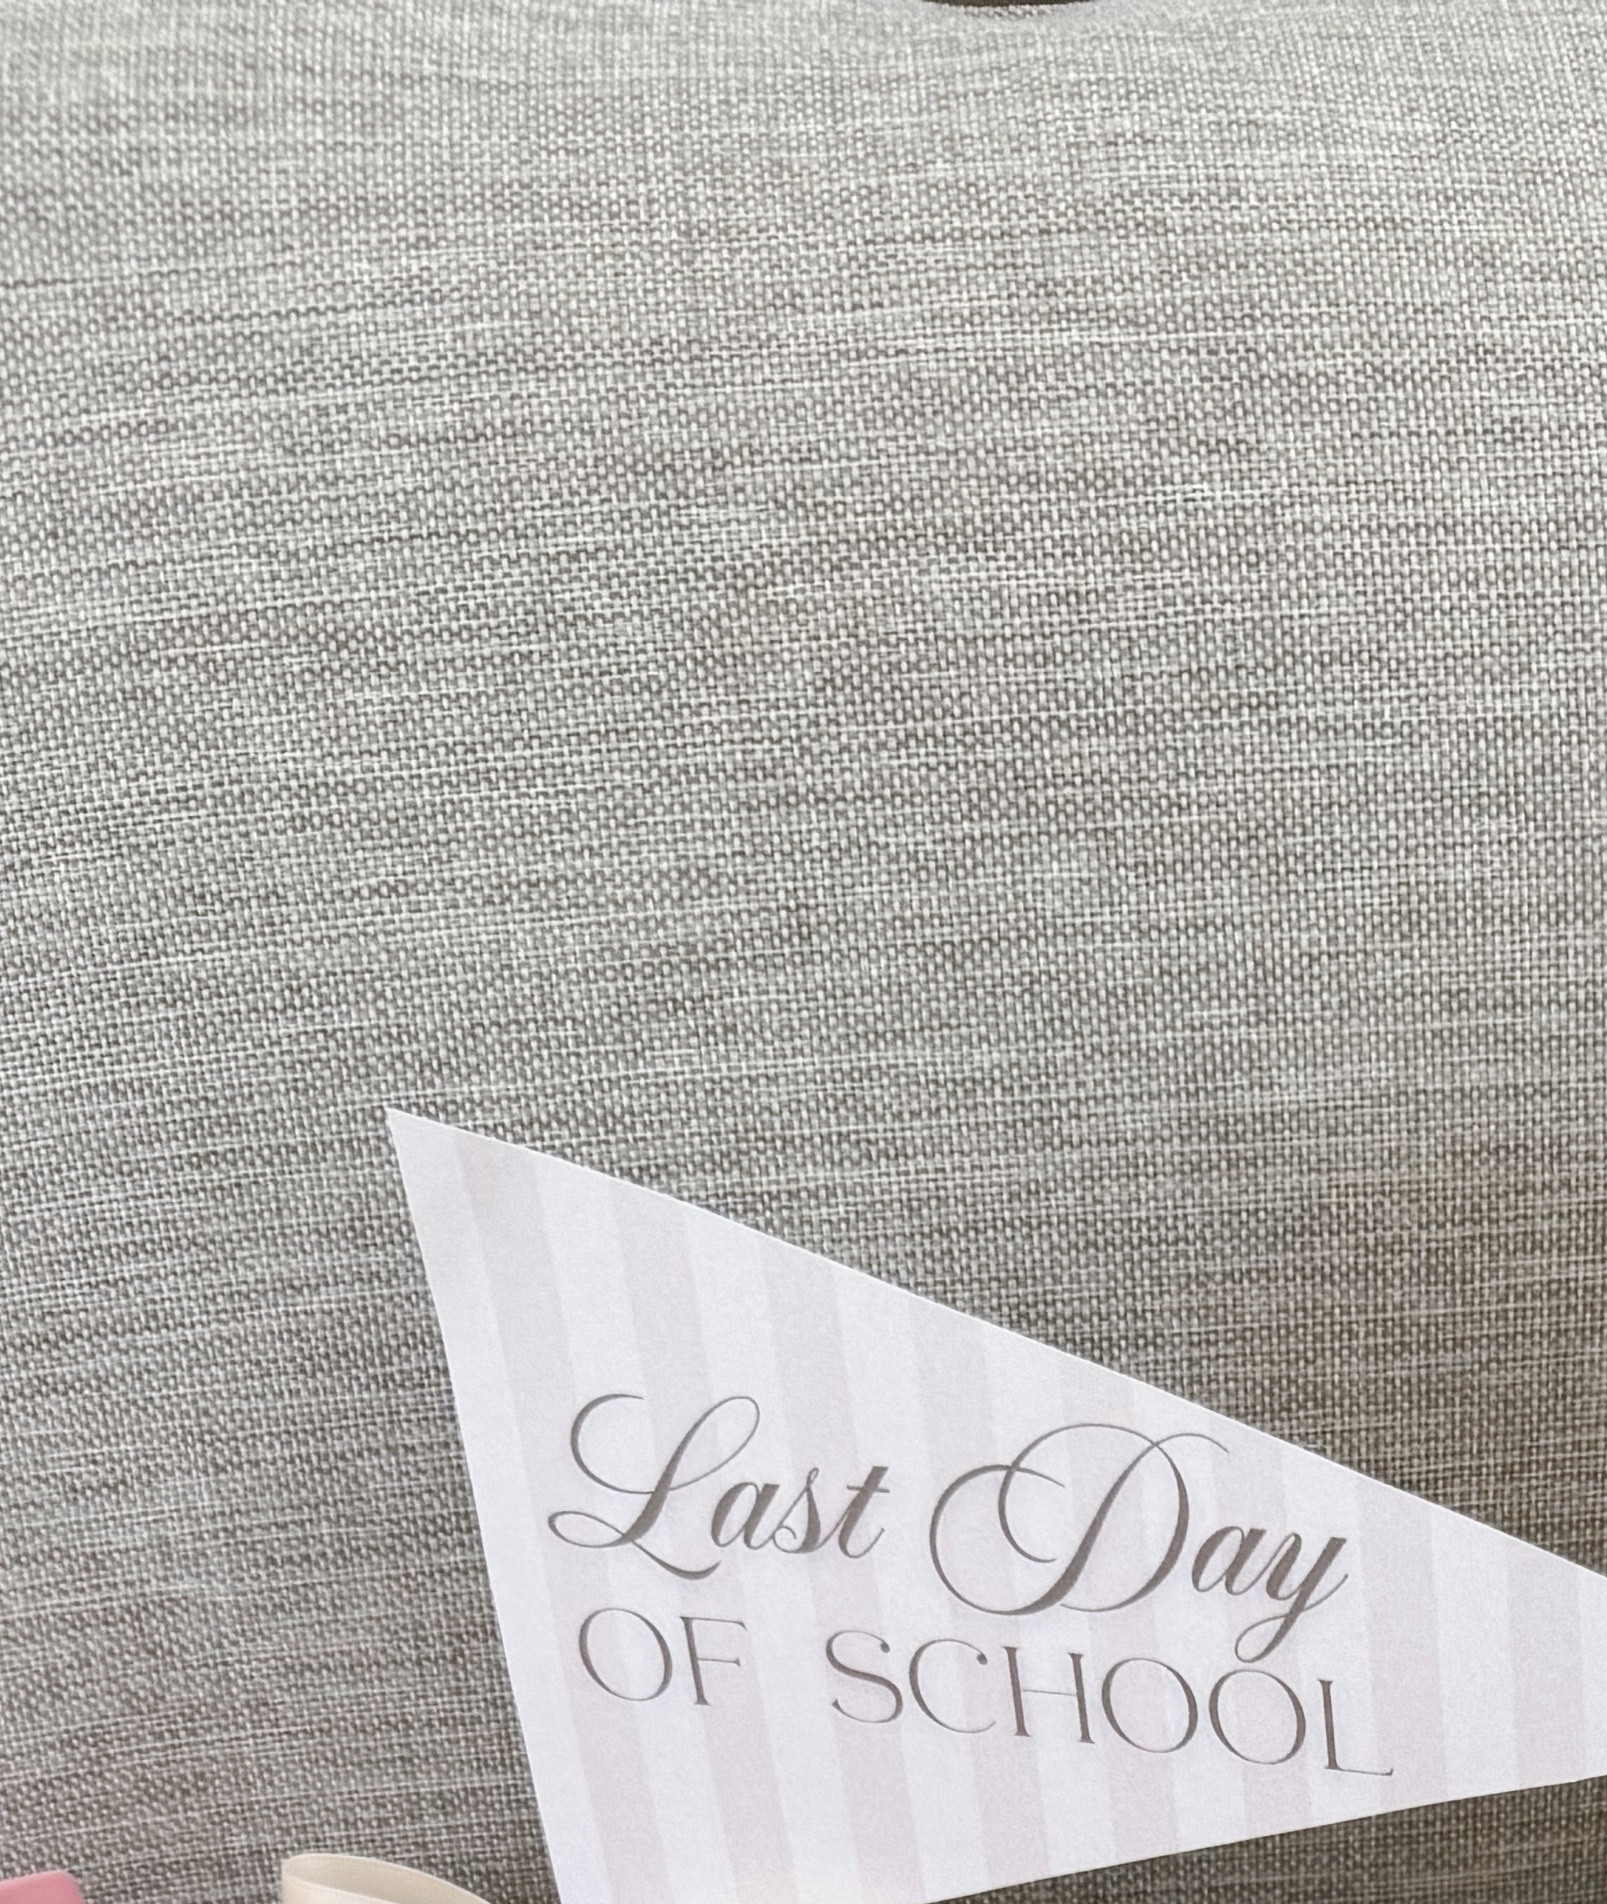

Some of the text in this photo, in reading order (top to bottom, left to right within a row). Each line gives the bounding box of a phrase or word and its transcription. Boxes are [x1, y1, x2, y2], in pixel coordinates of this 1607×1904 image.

[547, 1392, 1356, 1664] Last Day
[577, 1607, 1395, 1778] OF SCHOOL
